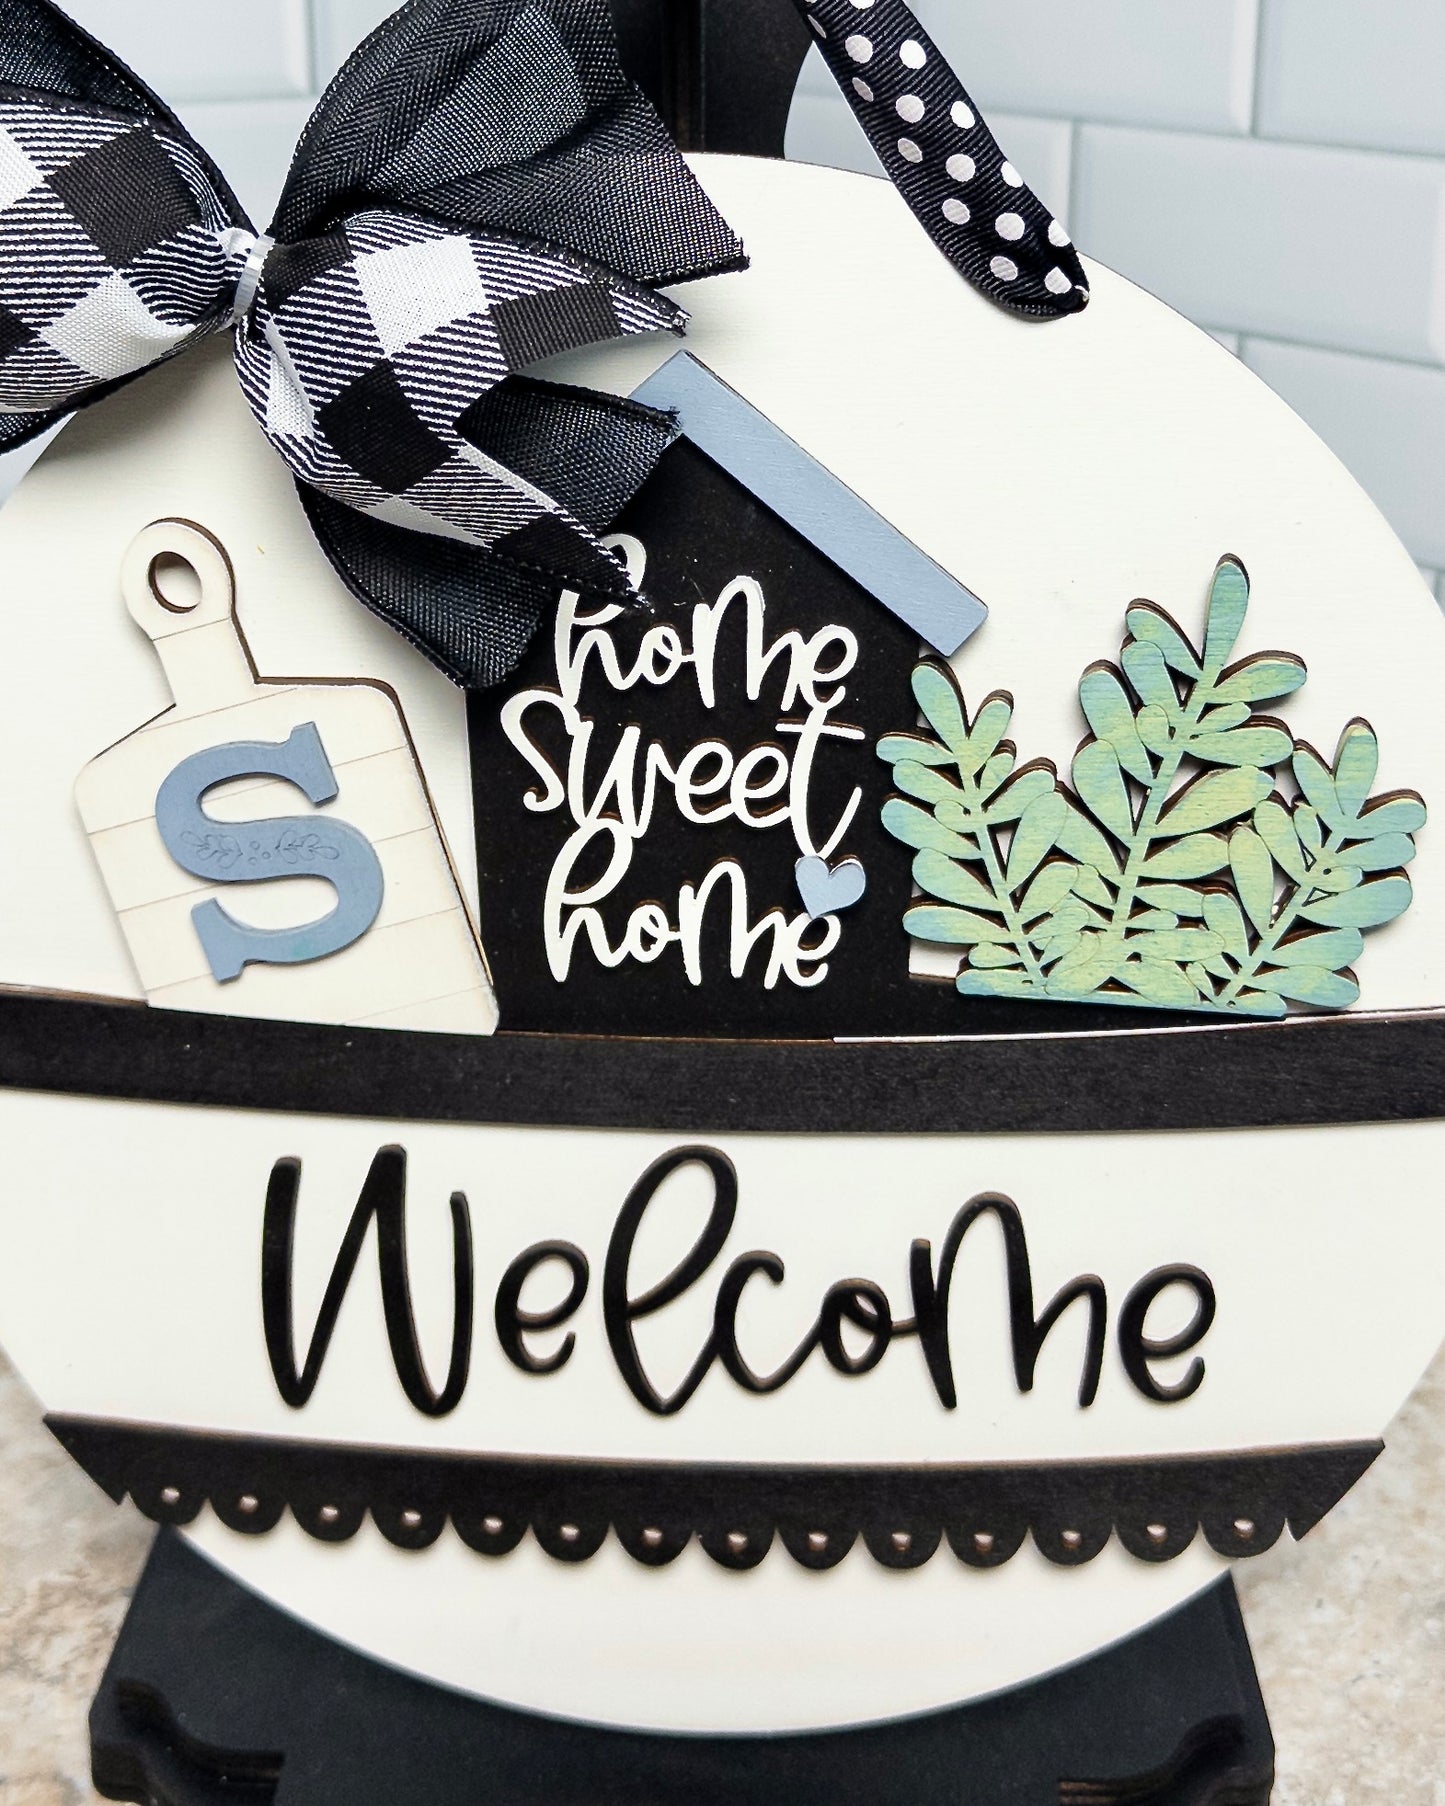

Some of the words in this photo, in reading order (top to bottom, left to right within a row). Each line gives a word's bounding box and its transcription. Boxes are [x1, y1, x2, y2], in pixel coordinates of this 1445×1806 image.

[554, 533, 859, 712] home
[154, 721, 385, 984] S
[544, 818, 842, 990] home
[260, 1143, 1217, 1417] Welcome
